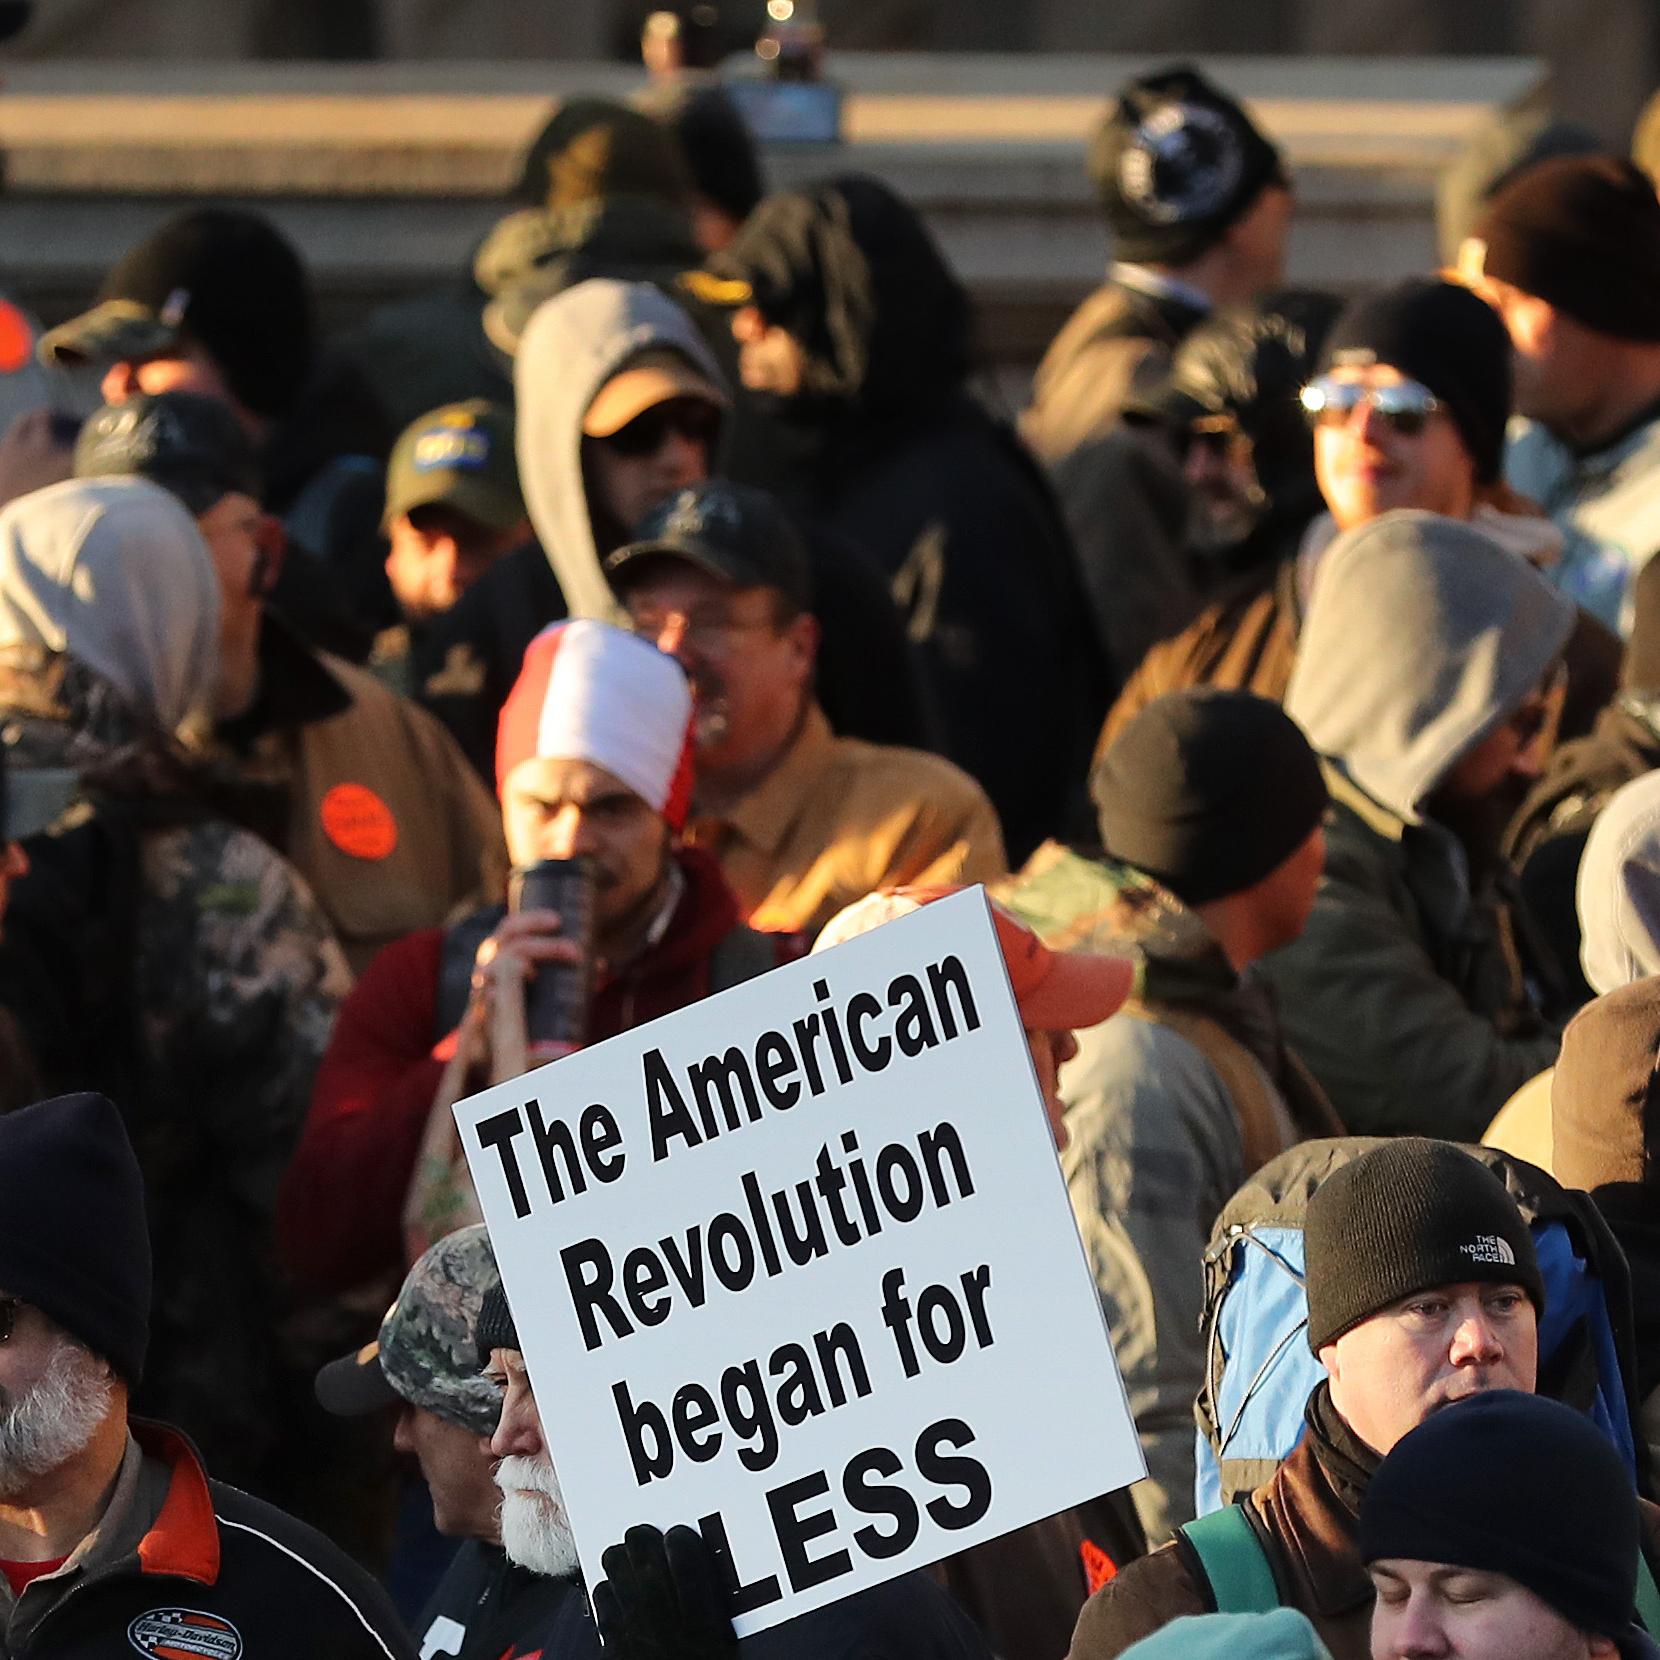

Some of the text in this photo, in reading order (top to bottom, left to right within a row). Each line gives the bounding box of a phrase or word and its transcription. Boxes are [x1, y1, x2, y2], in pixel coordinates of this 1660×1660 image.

[476, 954, 983, 1220] The American
[559, 1119, 976, 1352] Revolution
[1460, 1244, 1498, 1254] NORTH
[1476, 1235, 1496, 1245] THE
[1472, 1253, 1500, 1263] FACE
[612, 1263, 995, 1486] began for
[137, 1621, 236, 1650] Harley-Davidson
